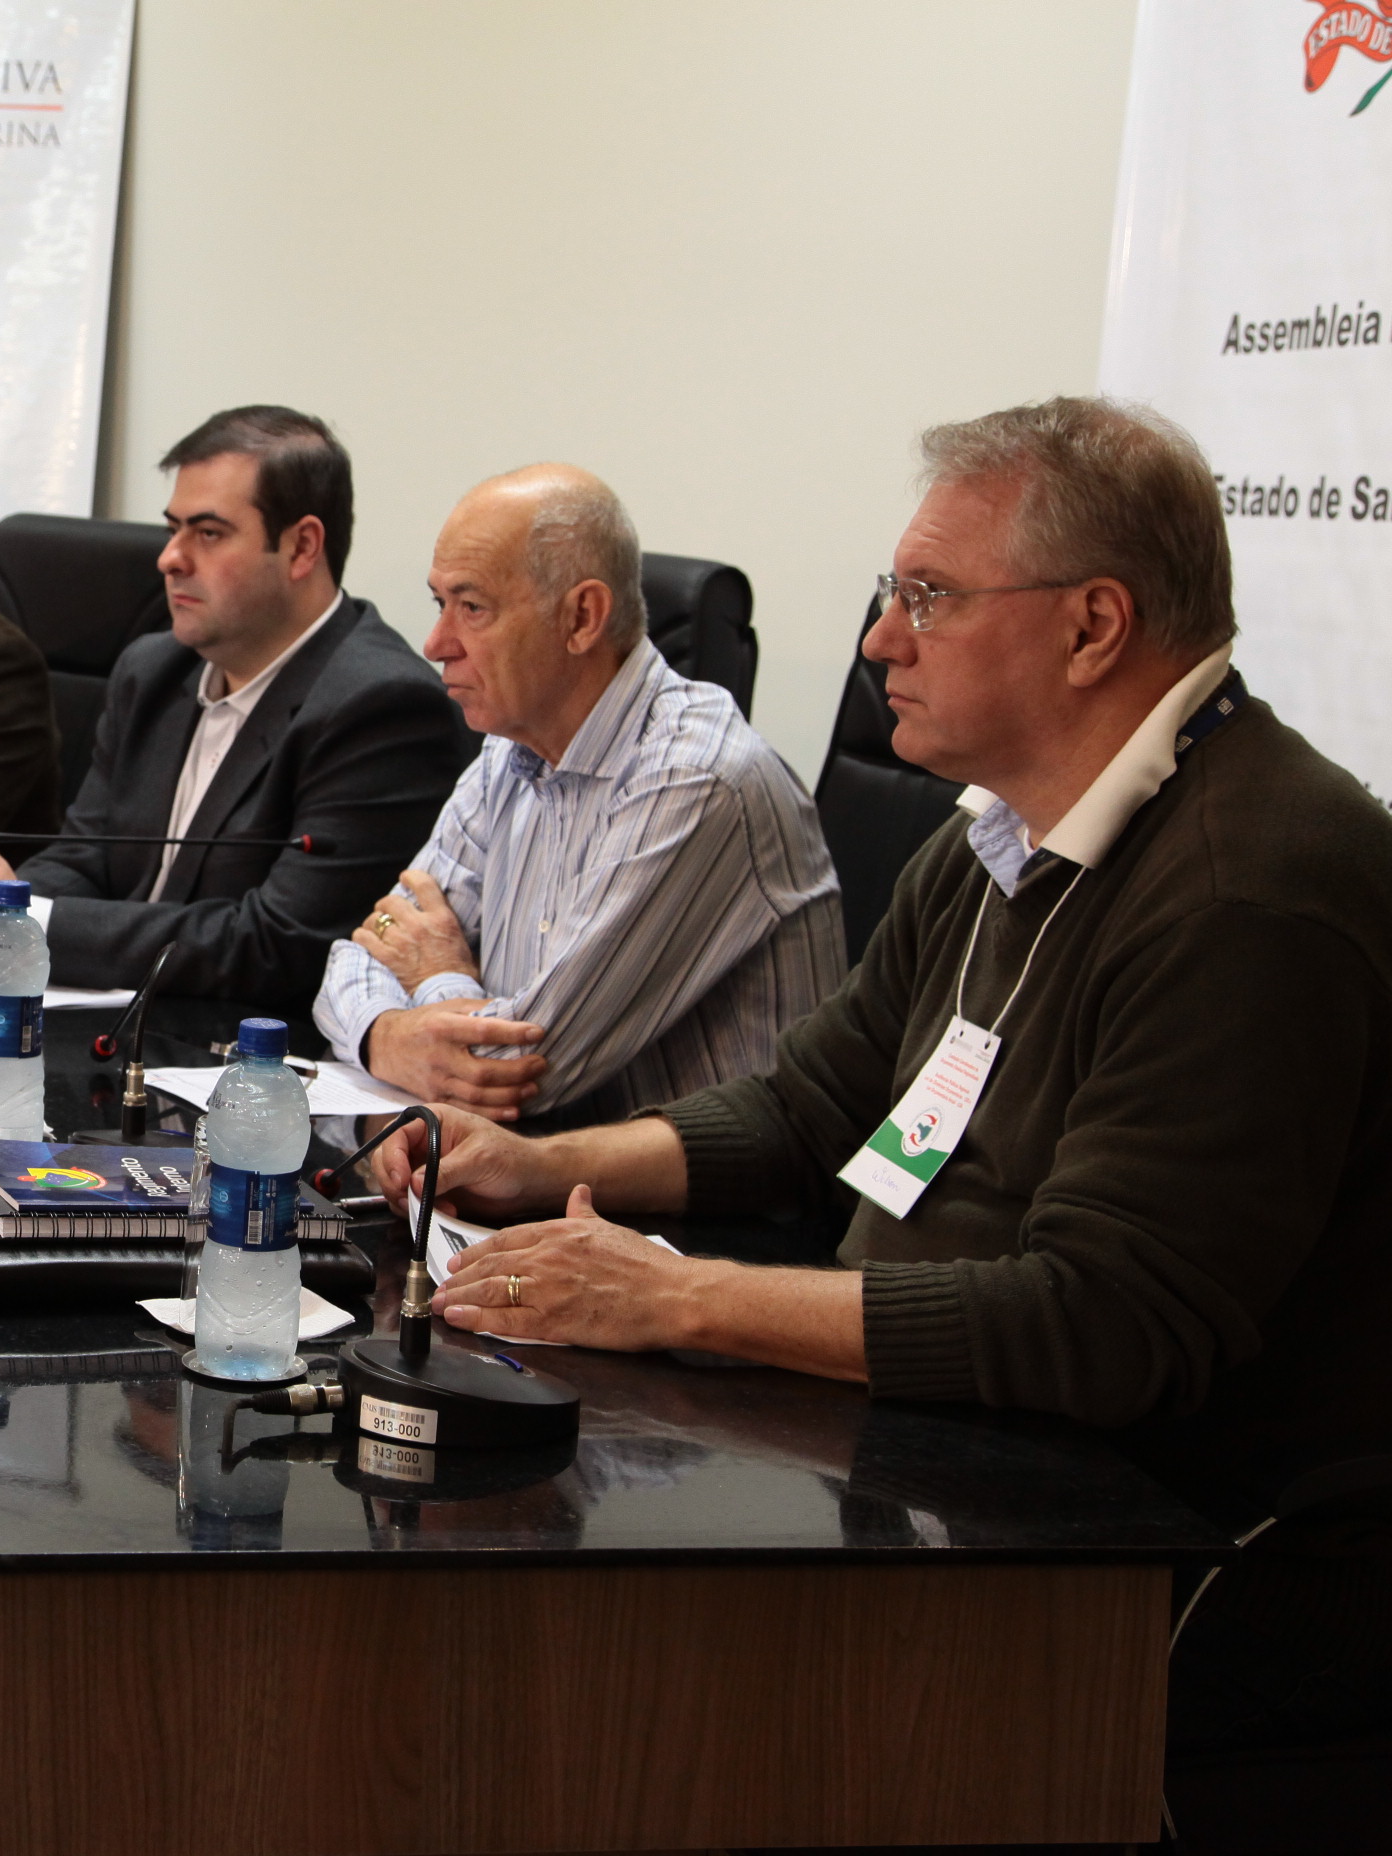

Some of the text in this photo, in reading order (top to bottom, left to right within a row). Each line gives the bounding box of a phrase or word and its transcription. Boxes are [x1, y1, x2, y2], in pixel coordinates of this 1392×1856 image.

[1309, 9, 1392, 59] ESTADO DE
[1222, 301, 1381, 356] Assembleia
[1309, 474, 1341, 519] de
[1351, 475, 1392, 522] Sa
[373, 1417, 421, 1438] 913-000
